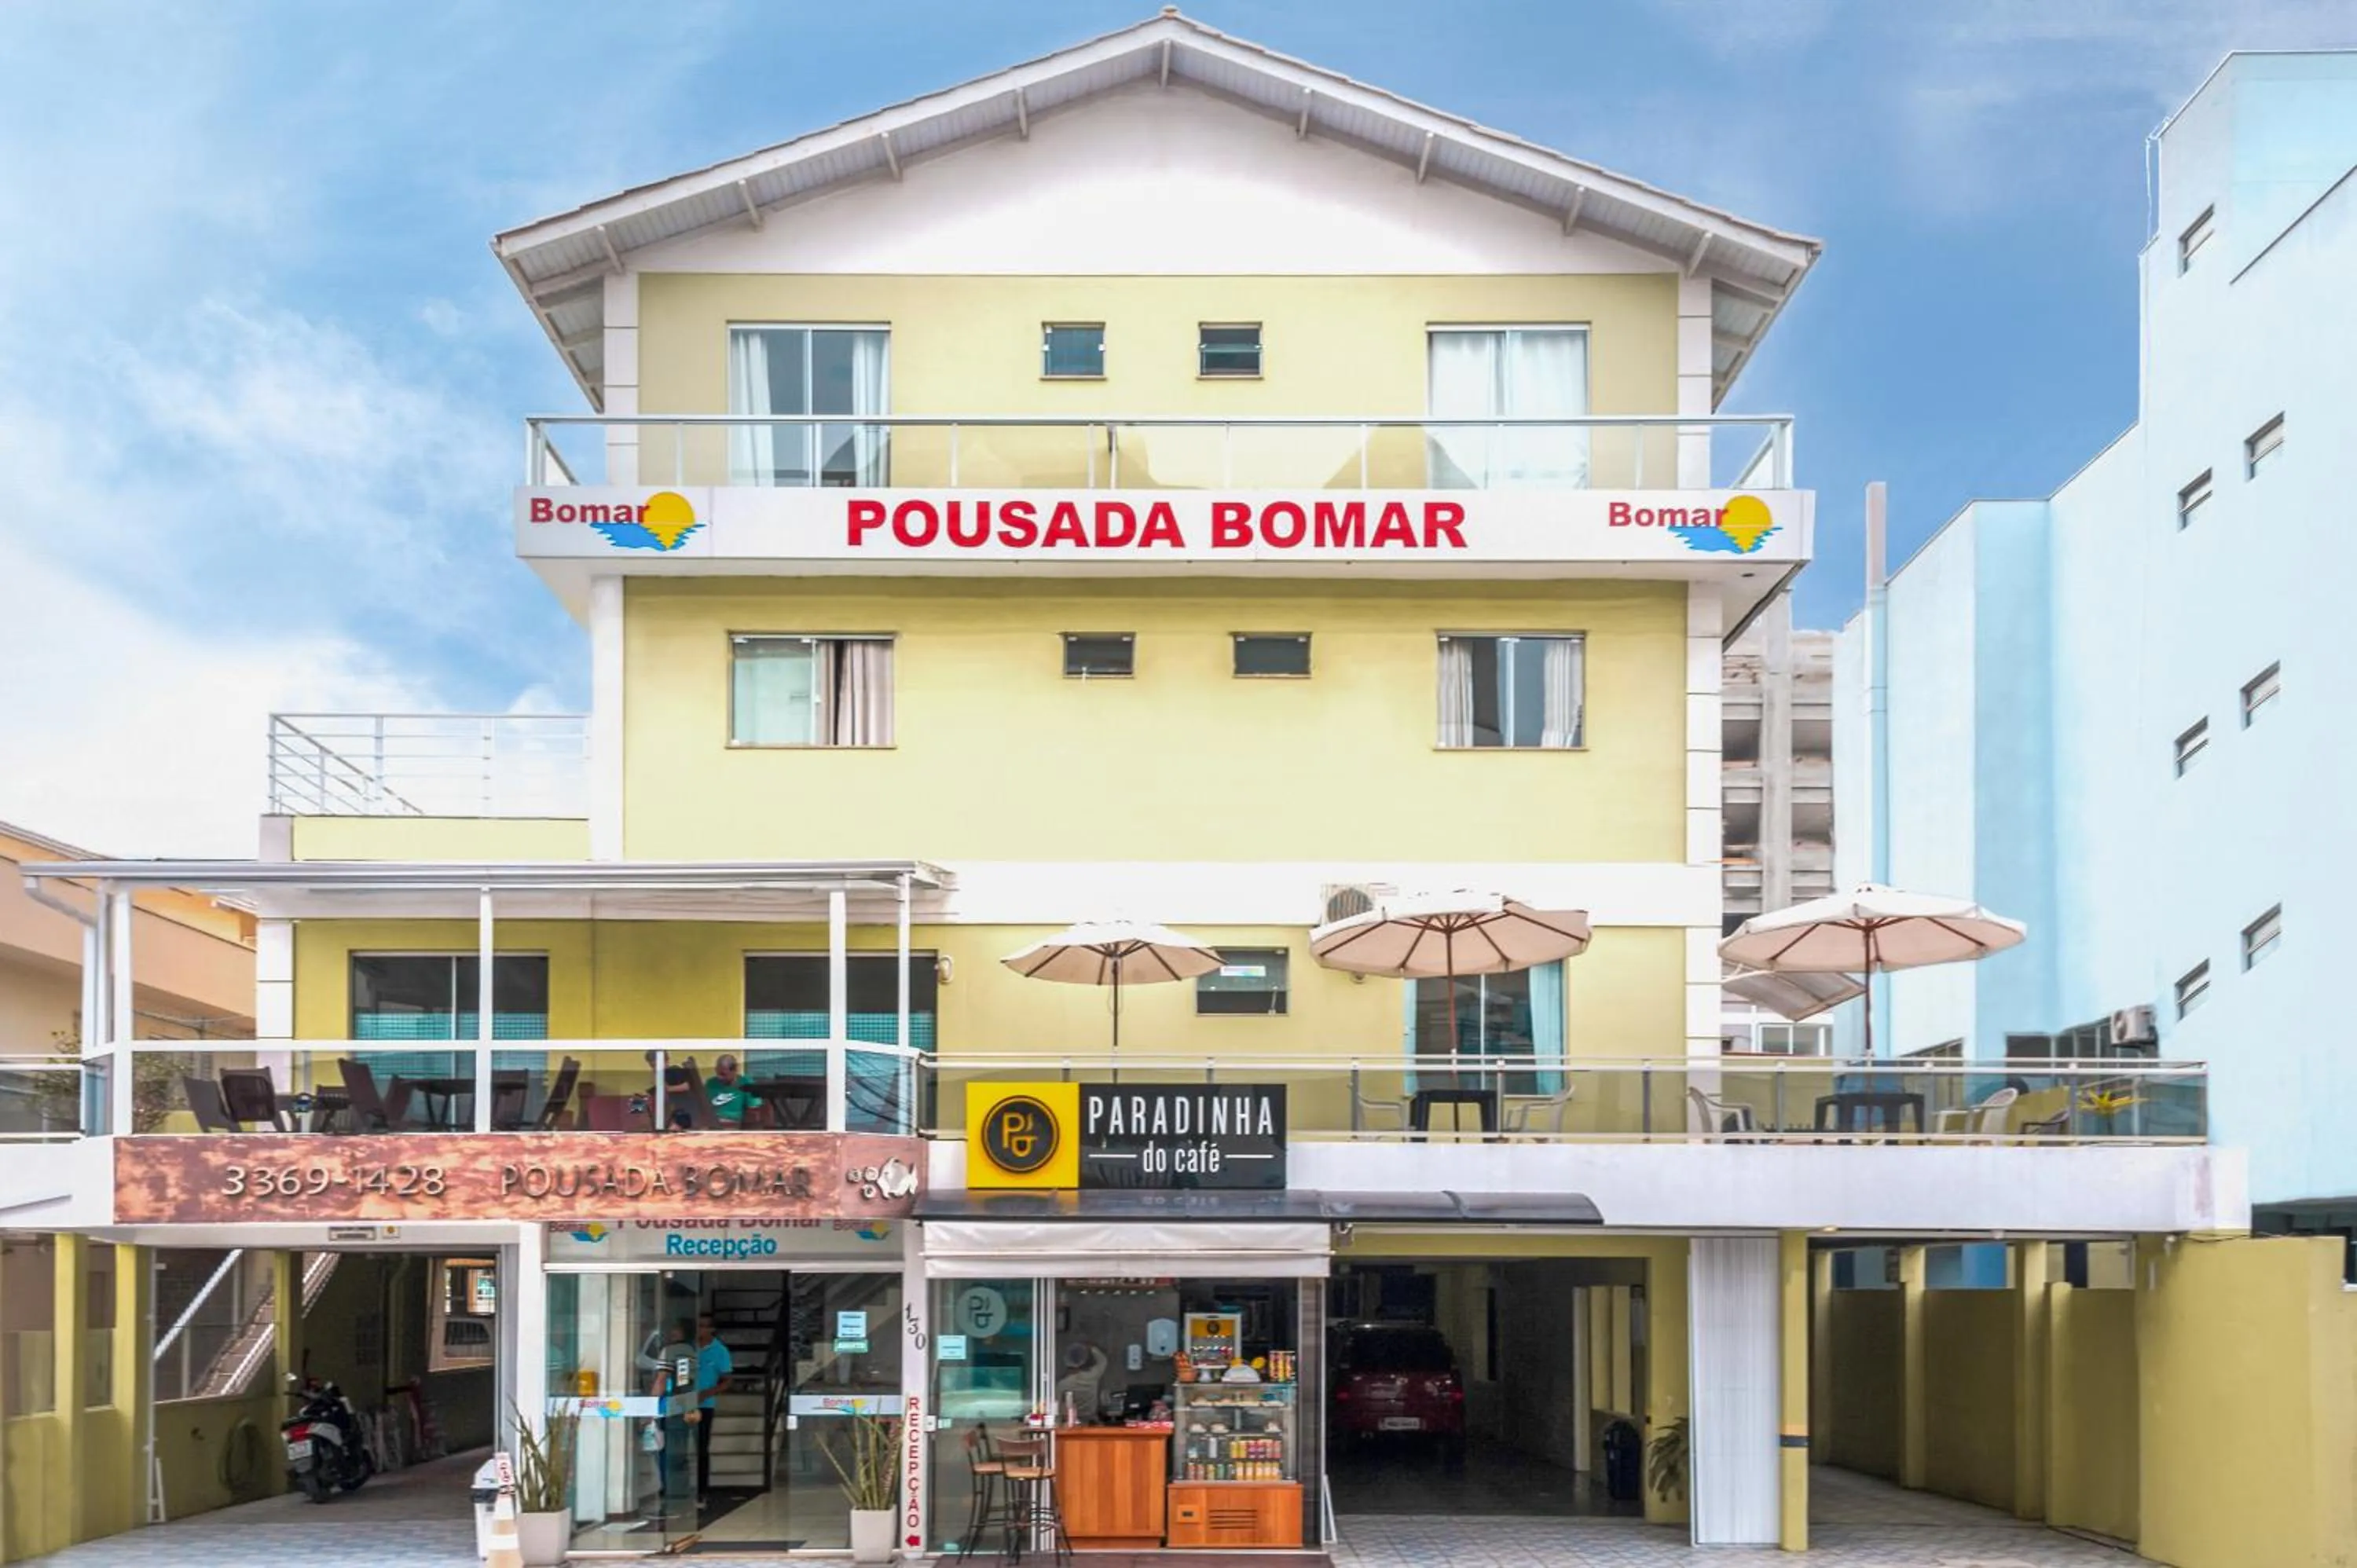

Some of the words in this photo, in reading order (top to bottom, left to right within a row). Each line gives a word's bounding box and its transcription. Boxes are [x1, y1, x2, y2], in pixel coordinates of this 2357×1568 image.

[530, 498, 651, 525] Bomar
[846, 498, 1186, 548] POUSADA
[1211, 501, 1466, 549] BOMAR
[1608, 501, 1729, 527] Bomar
[1088, 1095, 1274, 1135] PARADINHA
[1143, 1140, 1167, 1173] do
[1175, 1140, 1221, 1173] café
[221, 1164, 446, 1196] 3369-1428
[500, 1163, 673, 1199] POUSADA
[682, 1164, 816, 1199] BOMAR
[665, 1233, 778, 1259] Recepção
